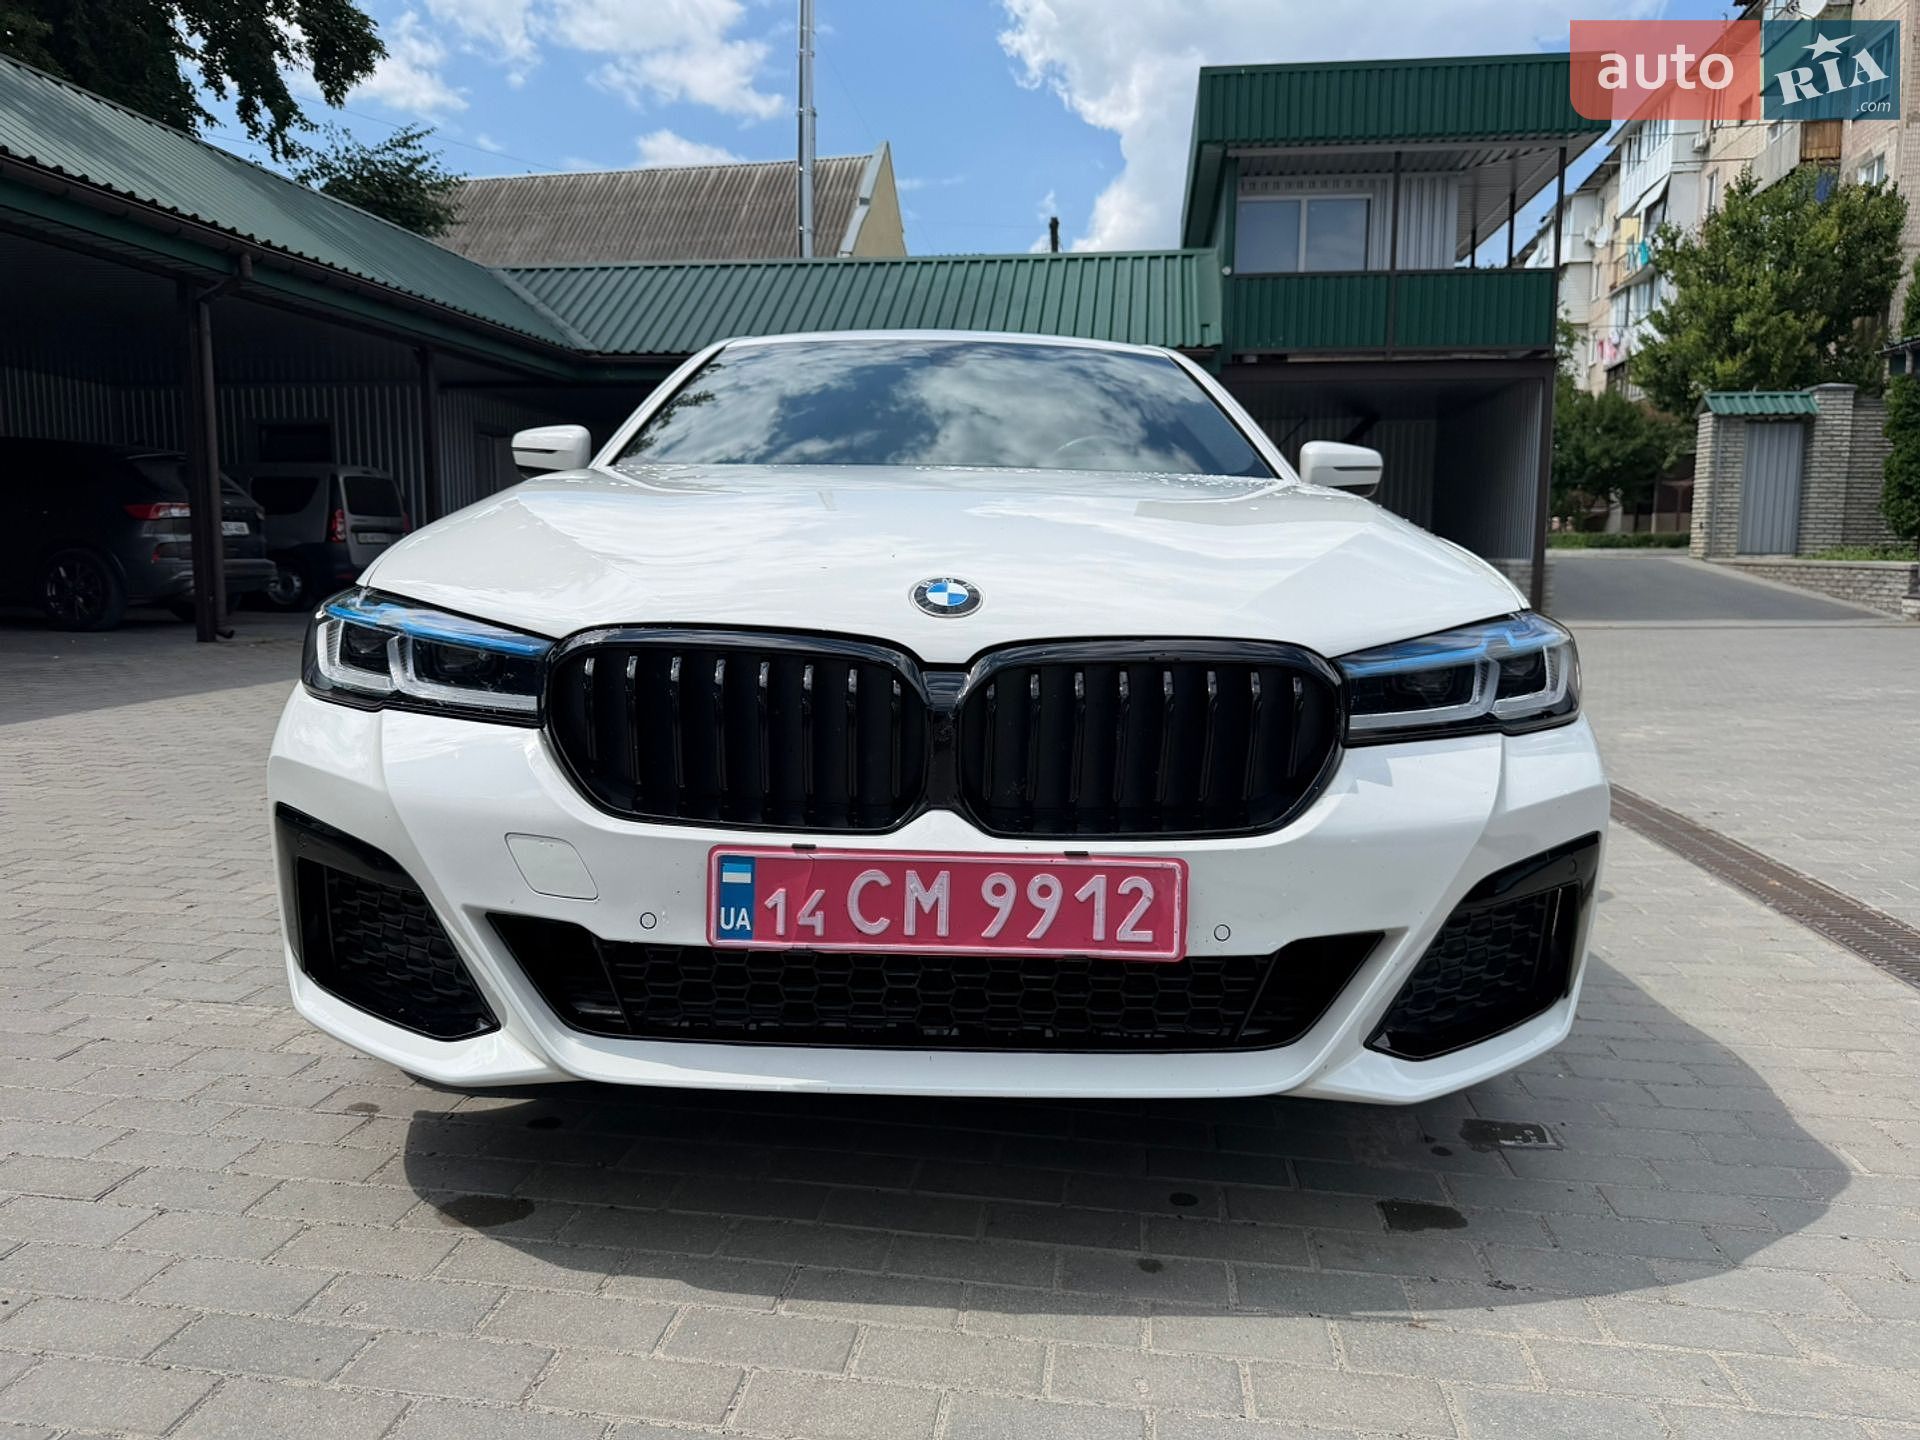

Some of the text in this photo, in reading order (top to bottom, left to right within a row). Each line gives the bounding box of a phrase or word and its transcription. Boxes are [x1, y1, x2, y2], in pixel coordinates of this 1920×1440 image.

[720, 907, 752, 931] UA
[764, 869, 1155, 943] 14 CM 9912
